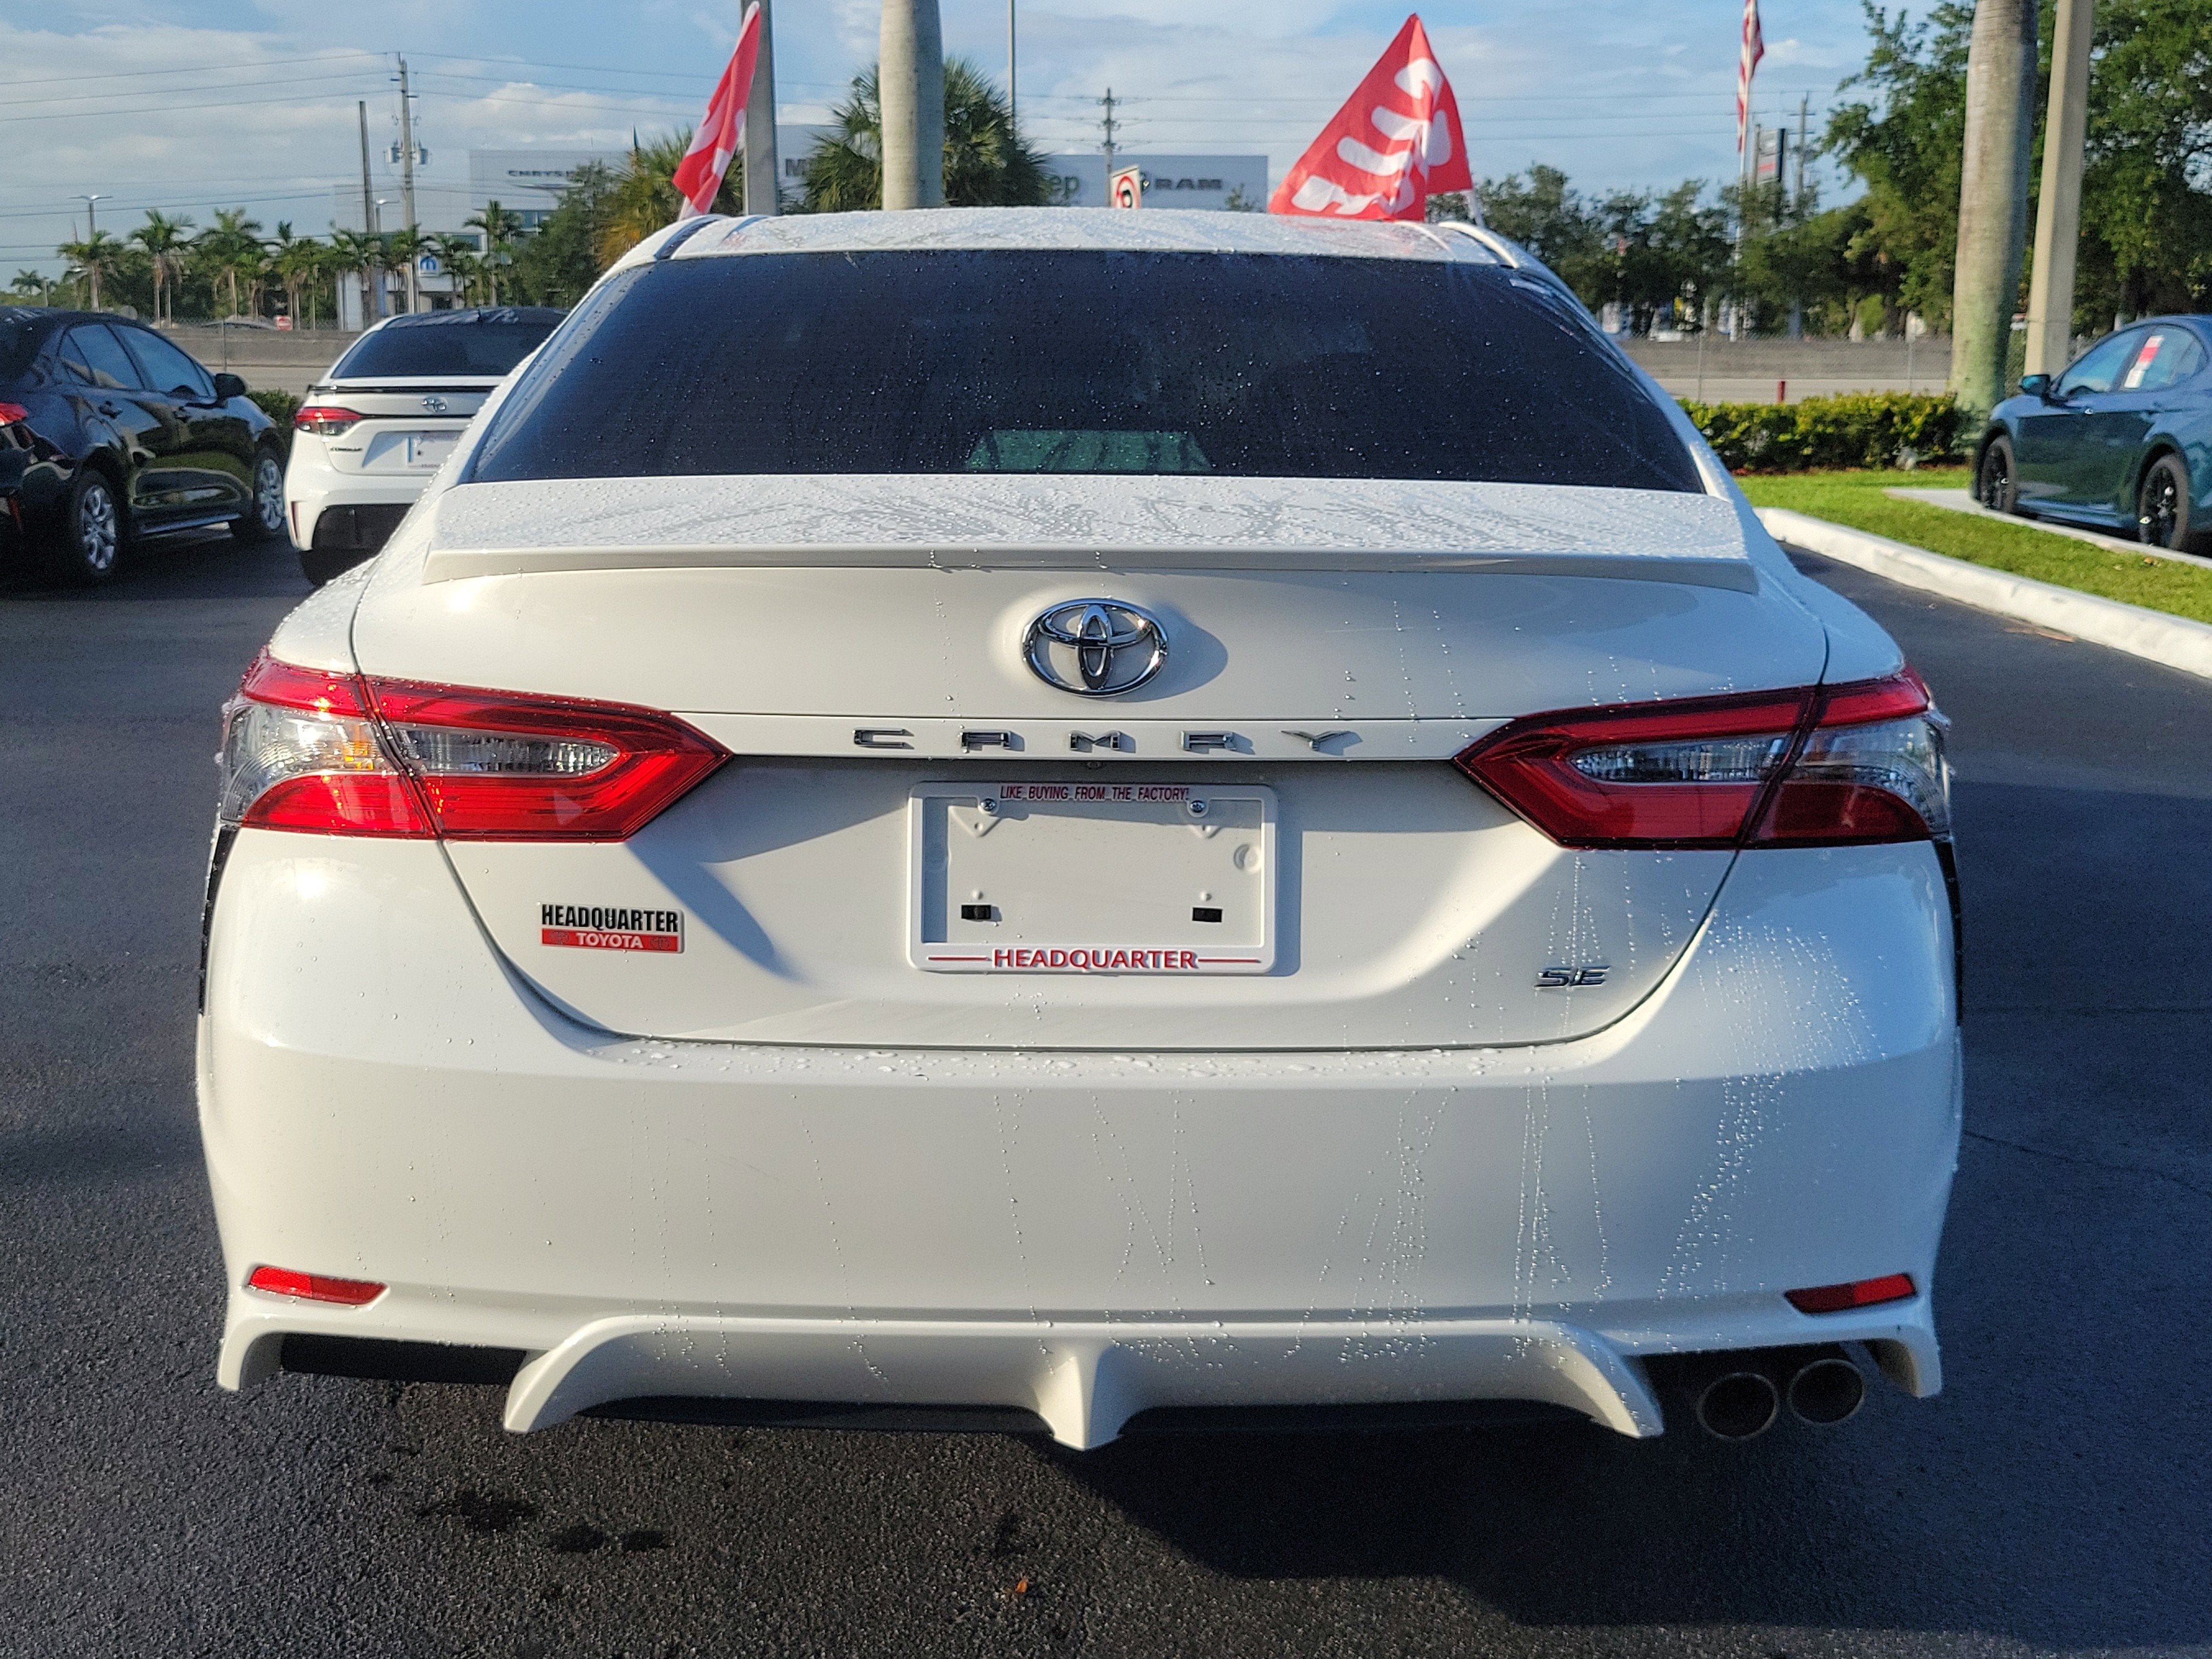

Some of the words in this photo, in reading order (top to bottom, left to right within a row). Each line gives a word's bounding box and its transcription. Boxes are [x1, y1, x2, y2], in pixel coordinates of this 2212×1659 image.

[1155, 179, 1222, 190] RAM
[854, 729, 1351, 753] CAMRY
[1000, 786, 1023, 799] LIKE
[1028, 786, 1069, 800] BUYING
[1074, 786, 1105, 800] FROM
[1112, 786, 1132, 800] THE
[541, 904, 678, 933] HEADQUARTER
[577, 932, 644, 949] TOYOTA
[993, 948, 1197, 970] HEADQUARTER
[1534, 966, 1611, 988] SE
